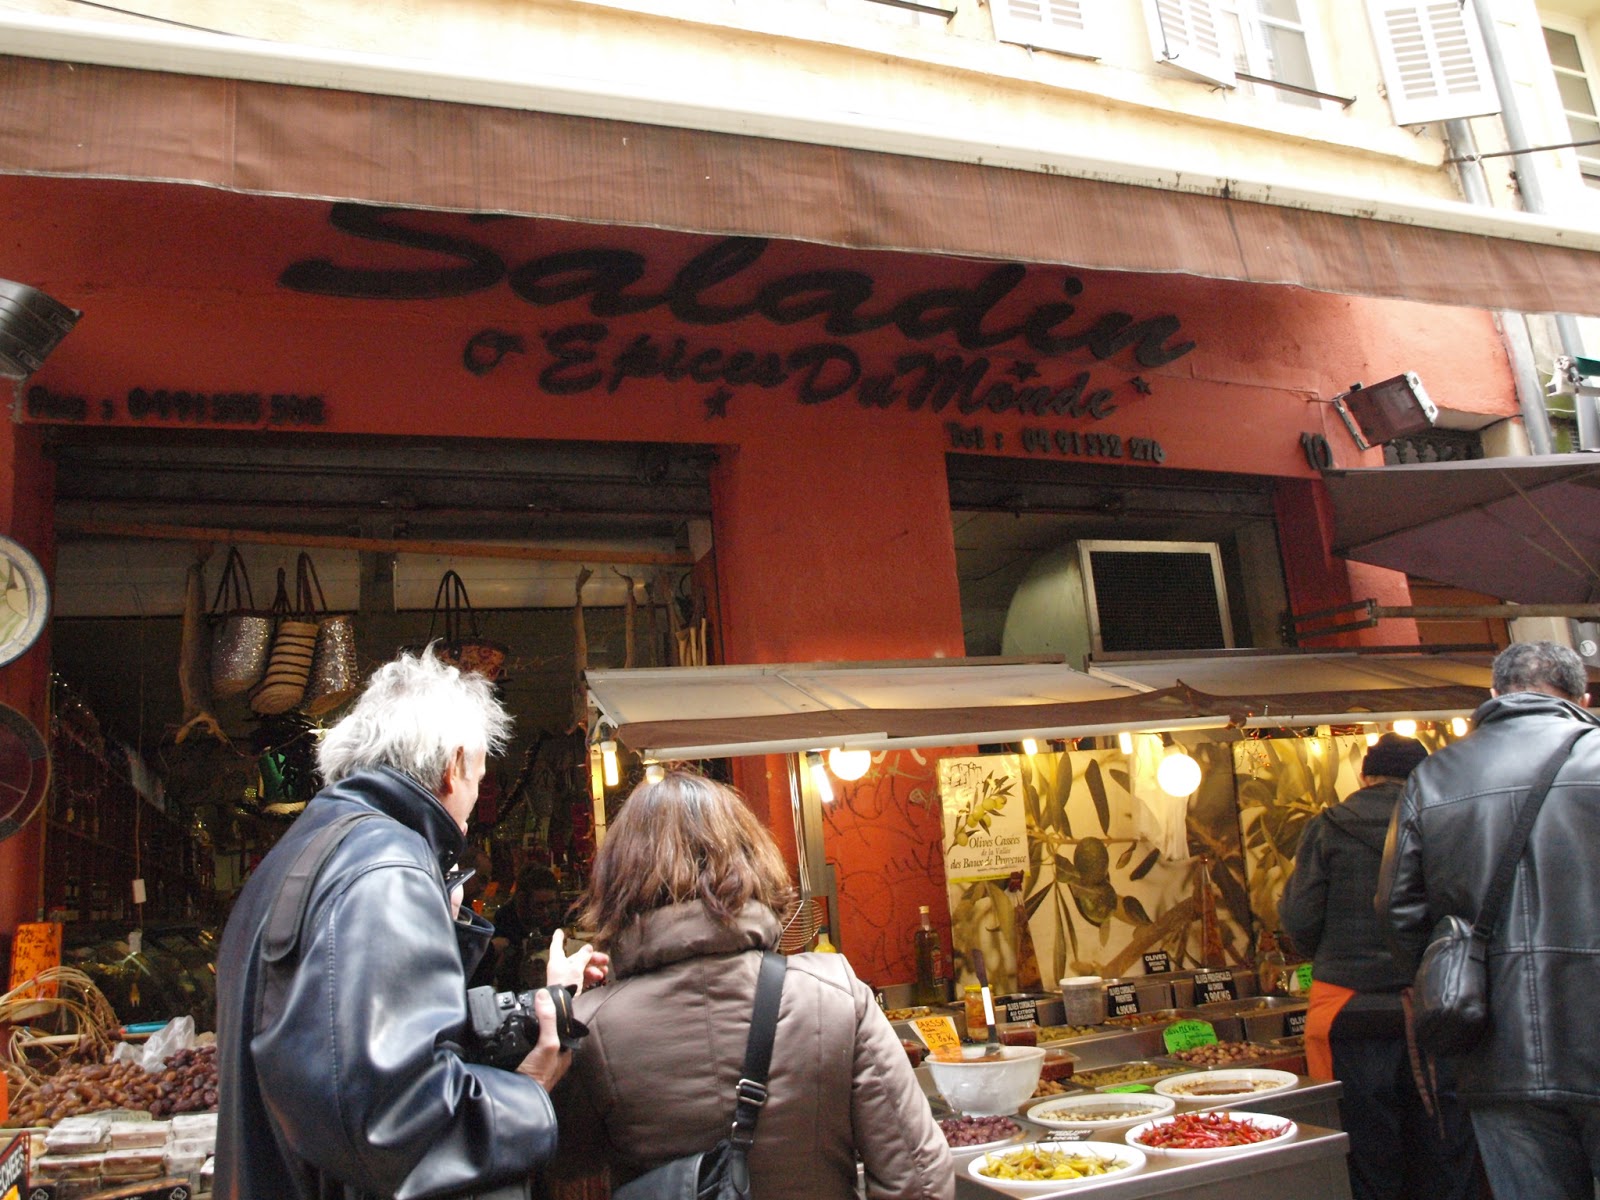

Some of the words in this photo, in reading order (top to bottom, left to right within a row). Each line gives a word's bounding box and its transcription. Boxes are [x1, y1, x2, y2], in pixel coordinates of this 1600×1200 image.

[277, 200, 1196, 368] Saladin
[787, 343, 900, 410] Du
[895, 353, 1118, 420] Monde
[969, 837, 993, 849] Olives
[995, 854, 1027, 866] Provence
[1144, 953, 1167, 962] OLIVES
[0, 1144, 25, 1197] CHEES
